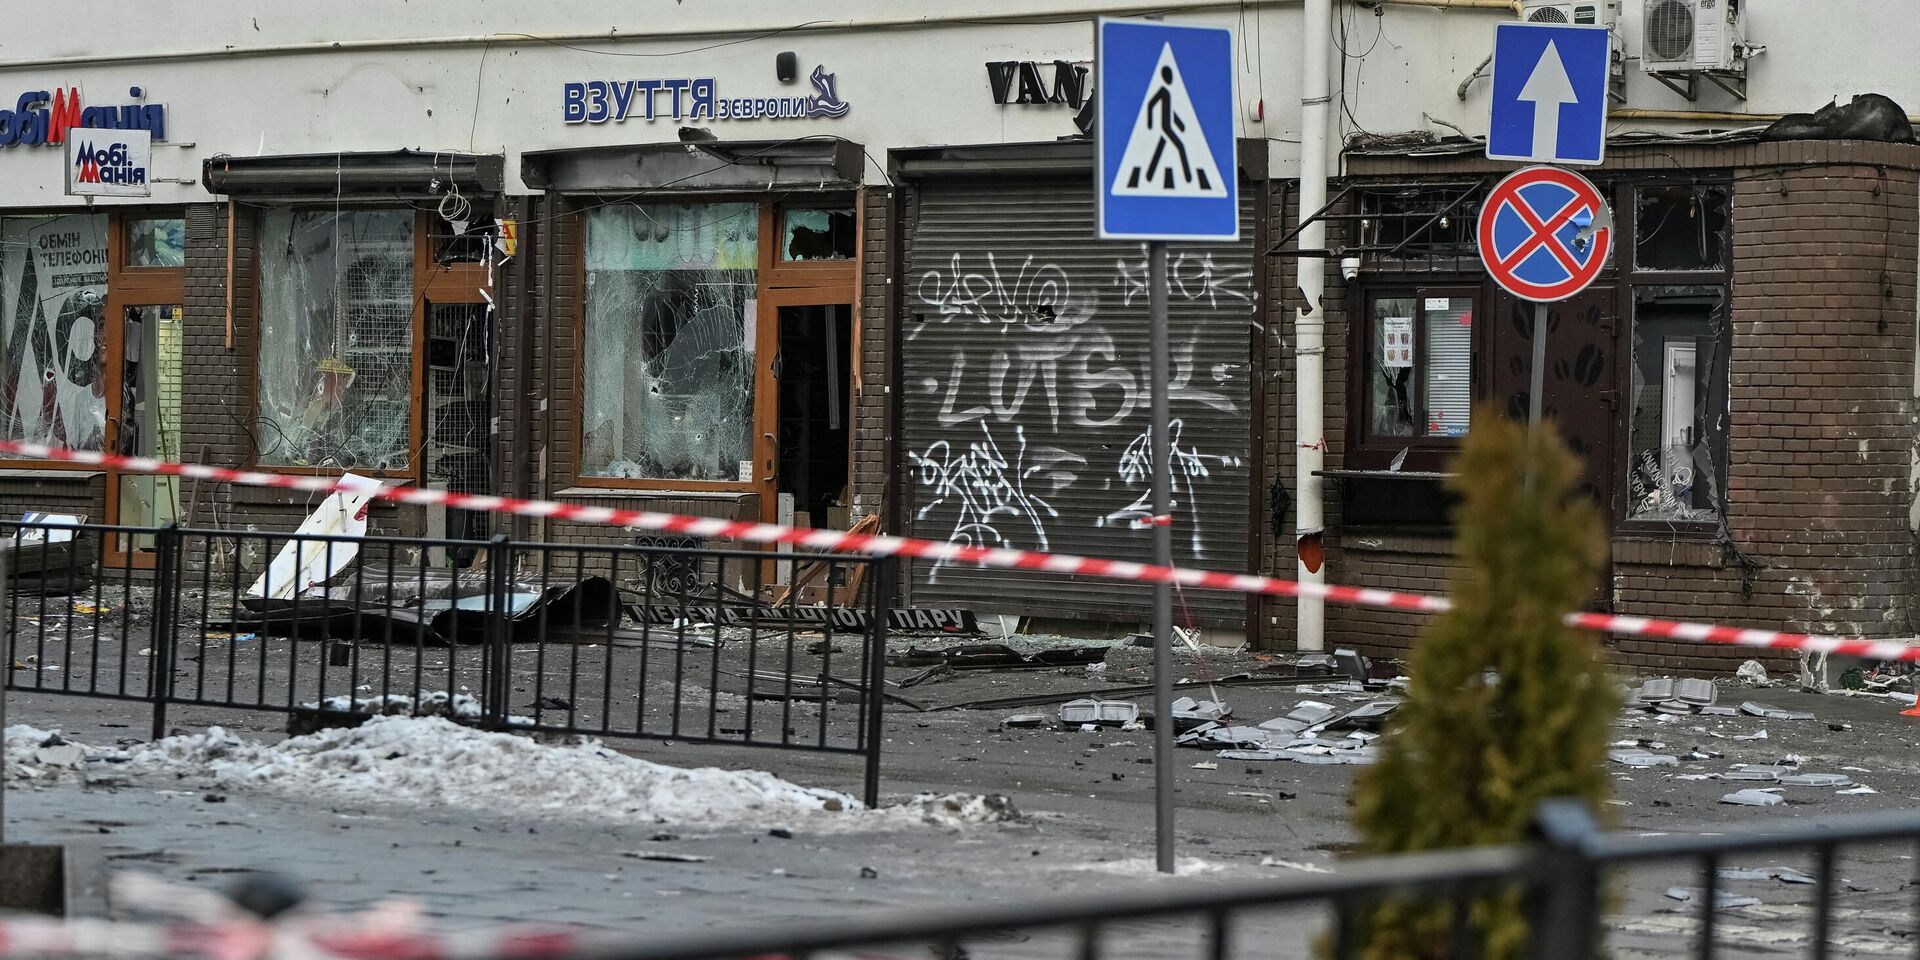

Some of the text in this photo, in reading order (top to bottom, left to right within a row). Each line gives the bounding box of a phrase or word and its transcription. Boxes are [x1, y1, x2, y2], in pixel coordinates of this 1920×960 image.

[563, 78, 716, 123] ВЗУТТЯ
[0, 86, 166, 146] обіМанія
[75, 140, 128, 168] Мобі
[40, 248, 108, 267] ТЕЛЕФОНІ
[893, 608, 964, 629] ПАРУ
